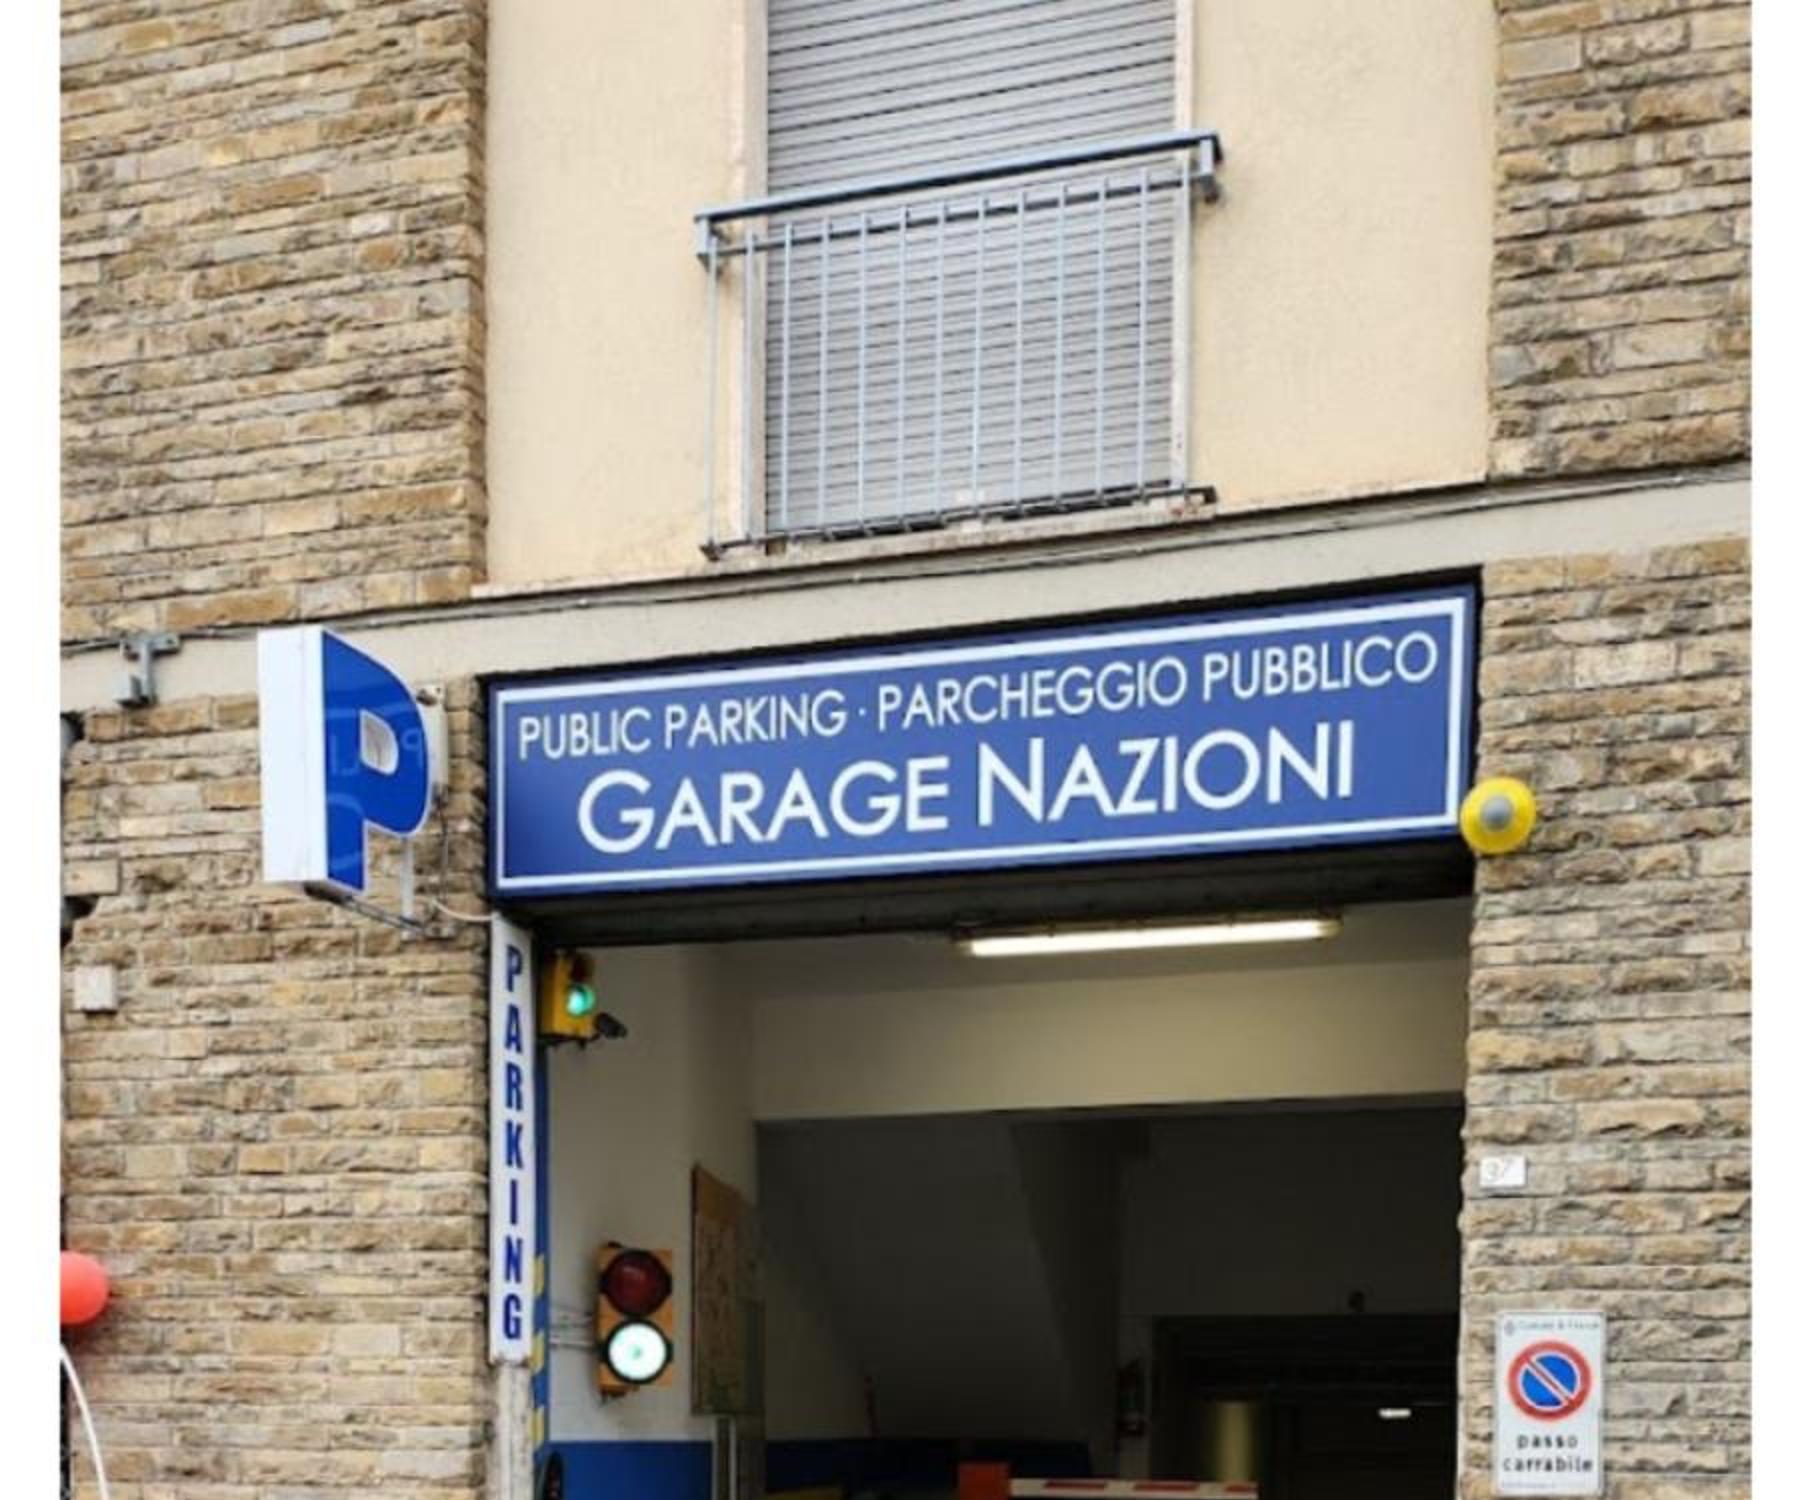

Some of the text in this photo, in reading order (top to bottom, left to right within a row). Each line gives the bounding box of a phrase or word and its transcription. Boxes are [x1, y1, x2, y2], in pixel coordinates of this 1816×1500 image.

[519, 631, 1439, 760] PUBLIC PARKING PARCHEGGIO PUBBLICO
[317, 629, 433, 894] P
[577, 720, 1354, 854] GARAGE NAZIONI
[502, 943, 526, 1341] PARKING
[1502, 1456, 1593, 1473] carrabile
[1516, 1434, 1578, 1450] passo
